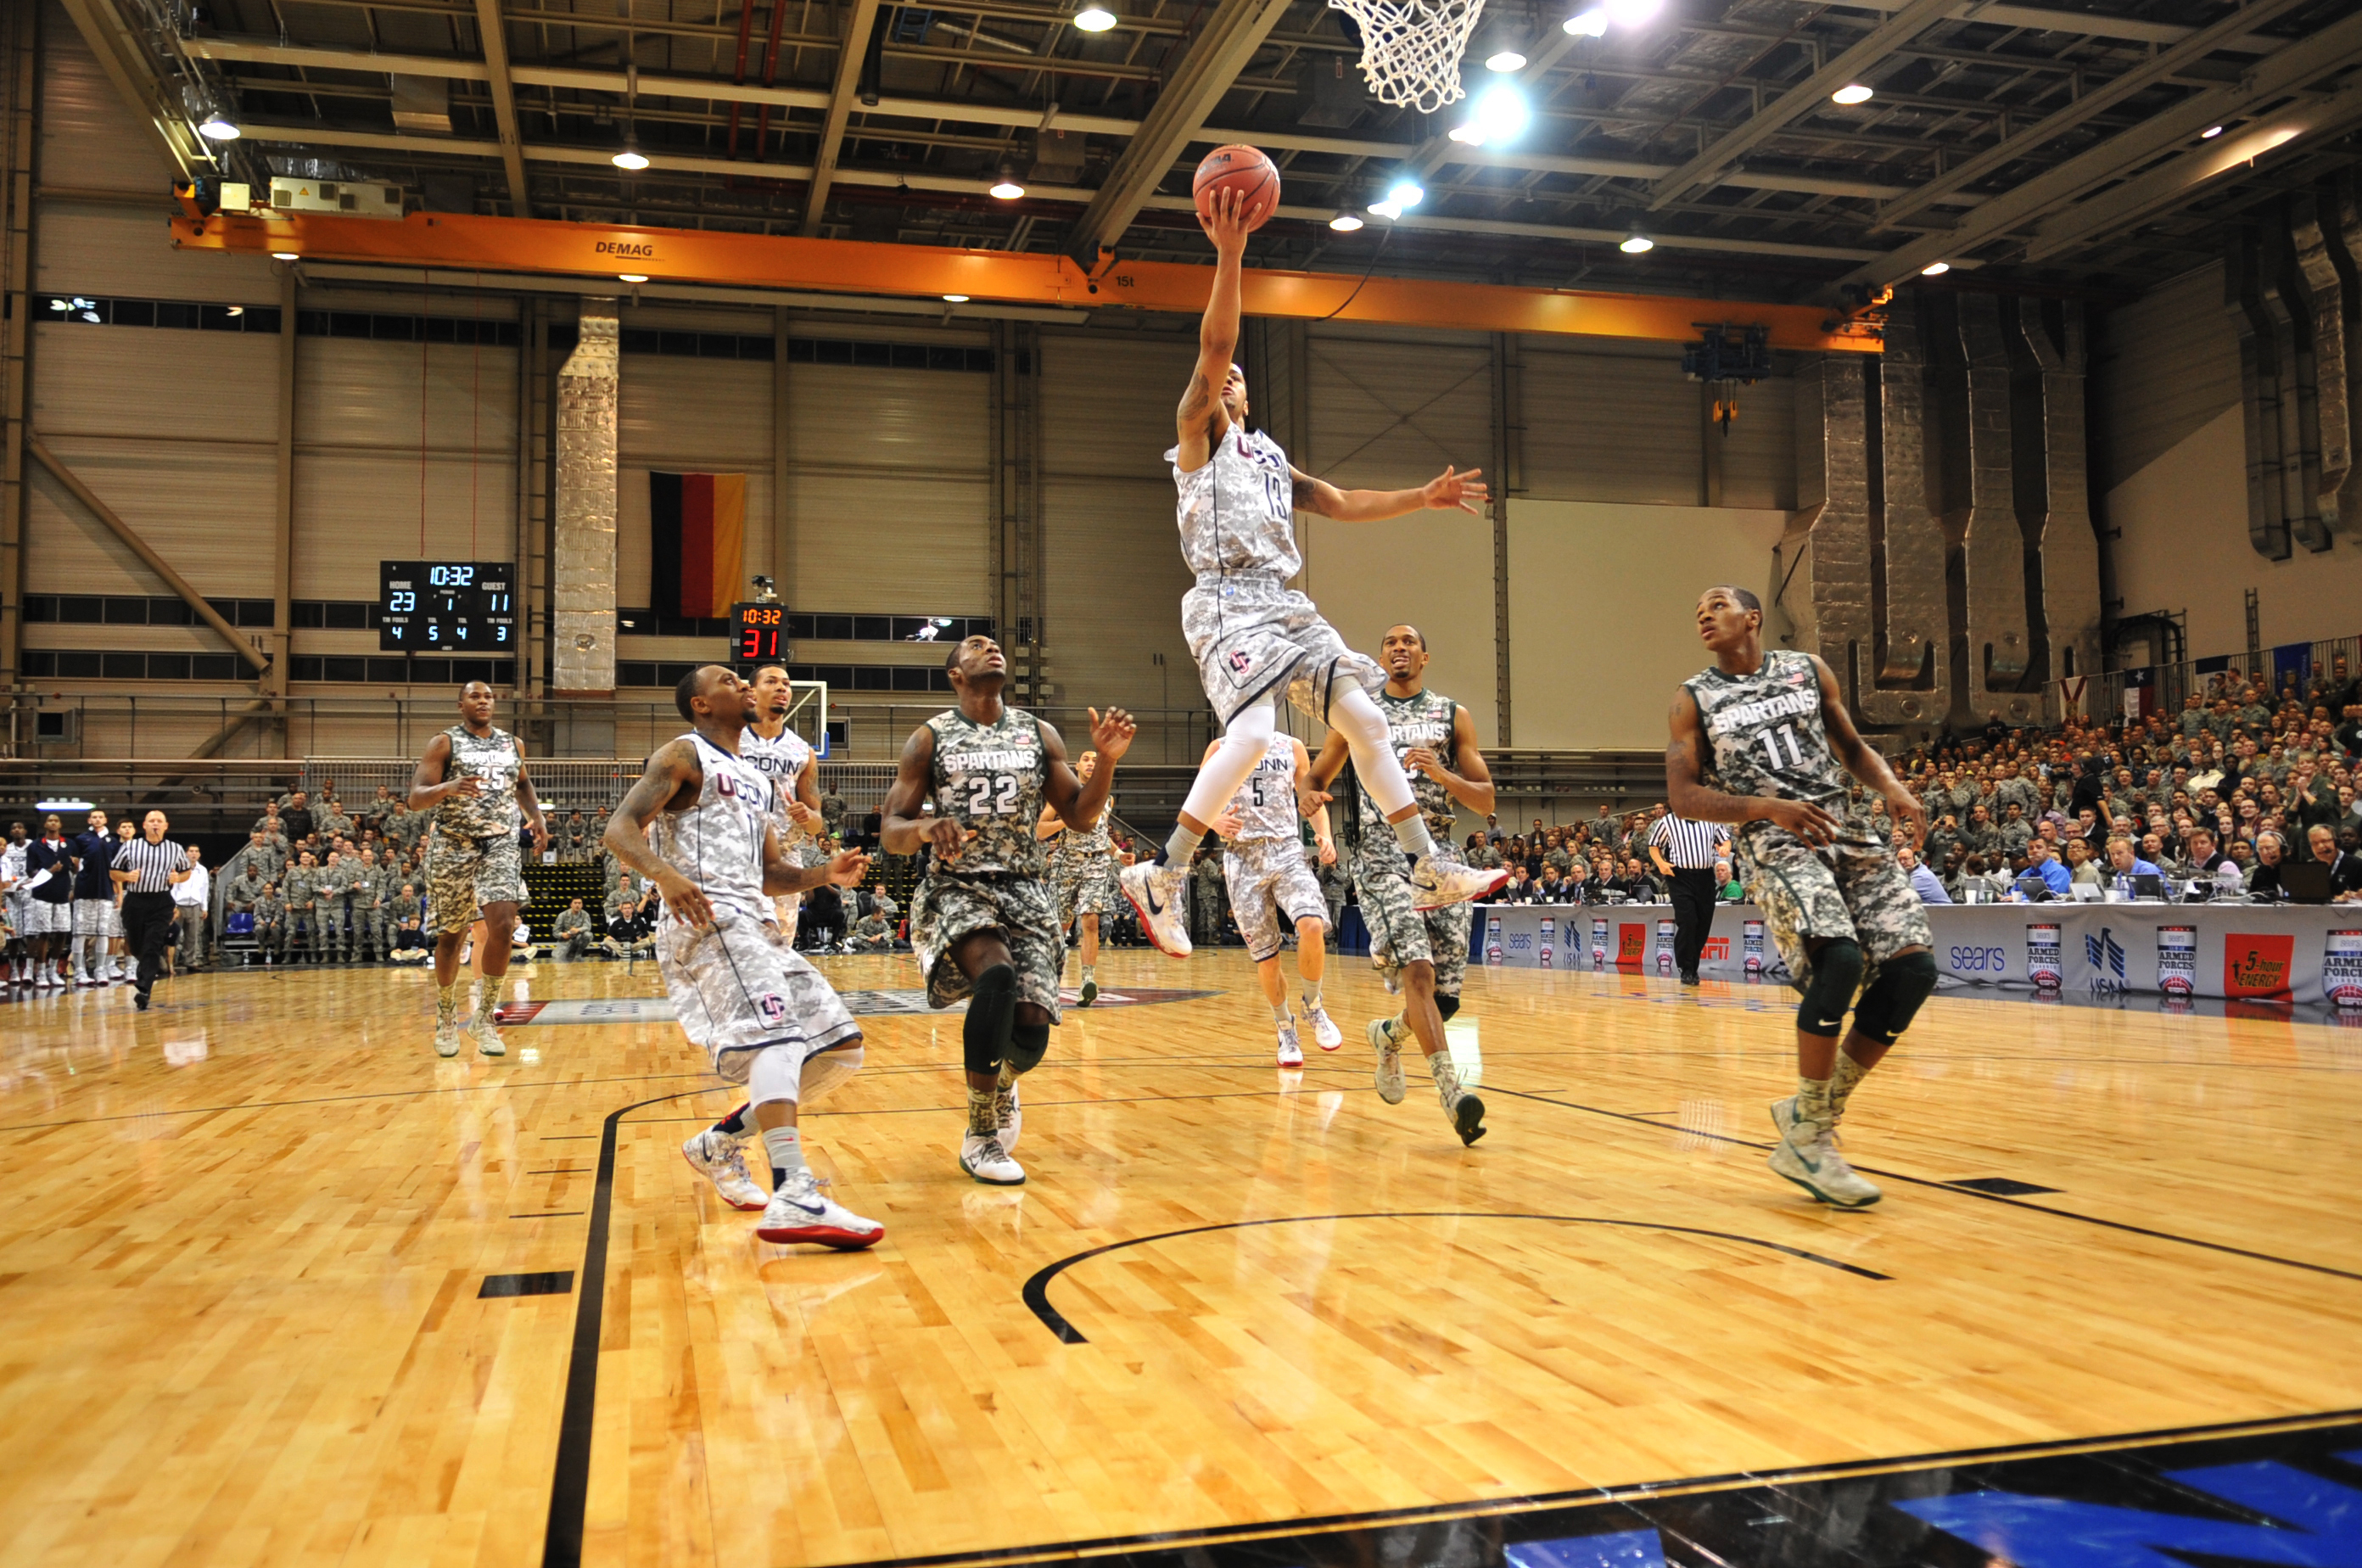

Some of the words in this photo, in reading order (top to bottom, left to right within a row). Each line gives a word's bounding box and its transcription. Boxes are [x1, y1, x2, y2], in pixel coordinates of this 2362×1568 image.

[596, 242, 652, 256] DEMAG
[1116, 276, 1134, 287] 15t
[1264, 472, 1287, 520] 13
[430, 566, 473, 585] 10:32
[389, 581, 411, 590] HOME
[481, 582, 506, 591] GUEST
[390, 591, 416, 611] 23
[447, 598, 453, 611] 1
[491, 594, 508, 611] 11
[743, 608, 781, 624] 10:32
[392, 626, 402, 639] 4
[428, 625, 439, 641] 5
[456, 627, 467, 639] 4
[496, 626, 507, 641] 3
[743, 630, 777, 657] 31
[1712, 689, 1816, 733] SPARTANS
[1387, 723, 1446, 742] ARTANS
[1756, 723, 1803, 770] 11
[744, 755, 799, 774] CONN
[943, 750, 1036, 772] SPARTANS
[476, 766, 505, 790] 25
[969, 776, 1017, 815] 22
[1252, 777, 1264, 806] 5
[1508, 933, 1532, 949] sears
[1699, 937, 1730, 960] SPN
[1951, 946, 2005, 971] sears
[2159, 952, 2195, 960] ARMED
[2245, 950, 2285, 972] 5-hour
[2324, 957, 2362, 967] ARME
[2159, 960, 2195, 970] FORCES
[2324, 967, 2362, 977] FORC
[2238, 972, 2281, 988] ENERGY
